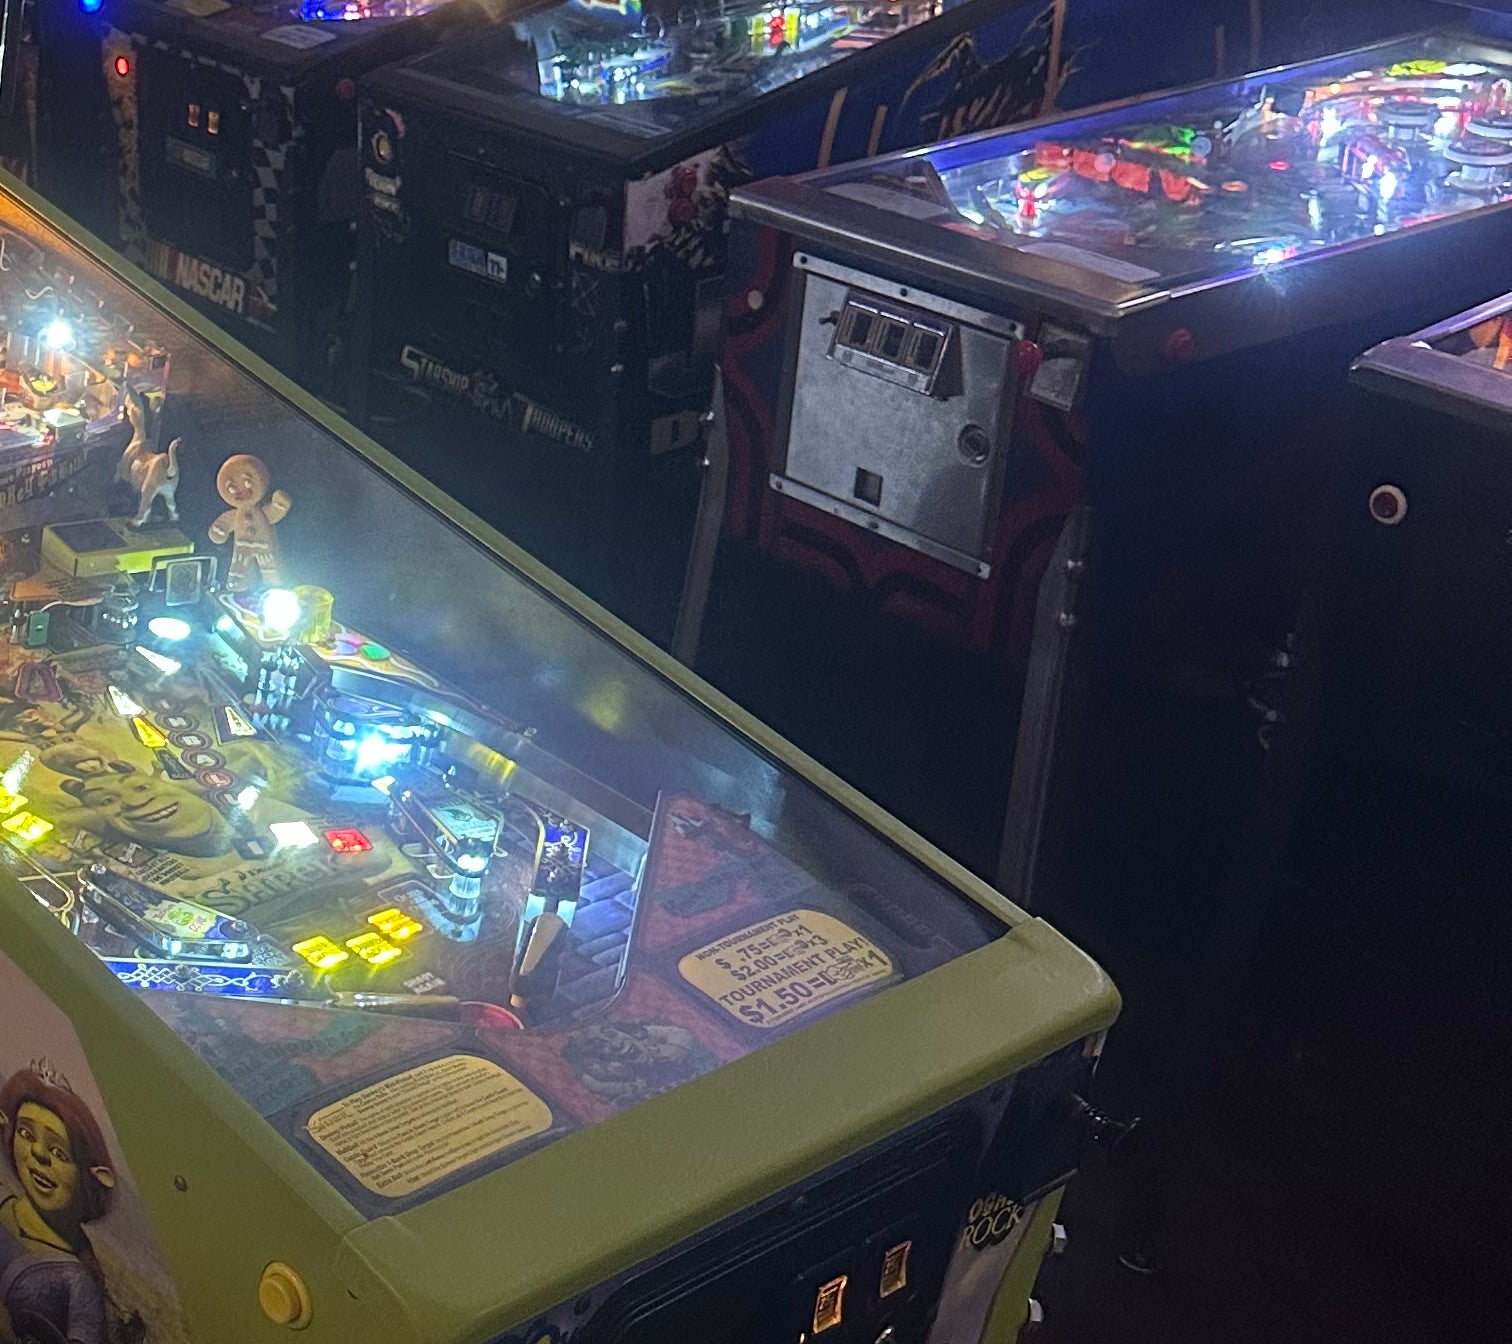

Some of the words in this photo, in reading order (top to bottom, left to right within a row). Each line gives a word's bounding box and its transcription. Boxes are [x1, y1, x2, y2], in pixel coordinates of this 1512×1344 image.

[175, 251, 246, 314] NASCAR
[779, 913, 799, 927] PLAY
[719, 953, 826, 1007] TOURNAMENT
[959, 1206, 1023, 1250] ROCK
